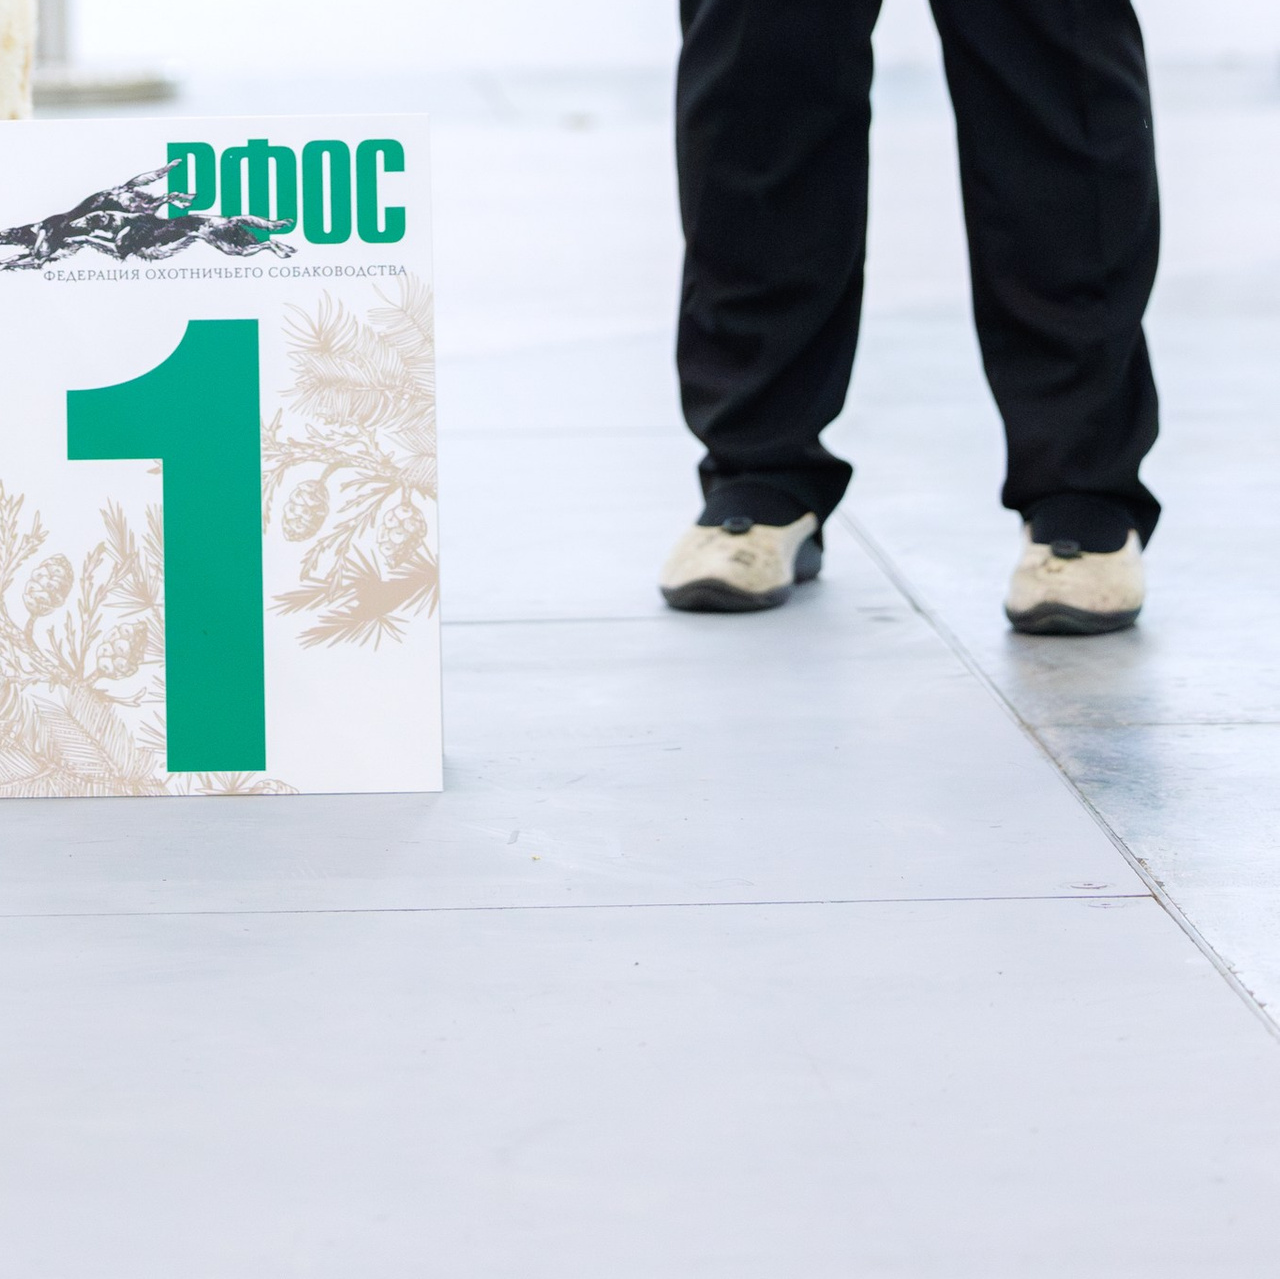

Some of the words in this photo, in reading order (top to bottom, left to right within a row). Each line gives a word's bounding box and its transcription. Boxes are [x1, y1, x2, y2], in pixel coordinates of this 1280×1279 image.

[166, 138, 406, 245] РФОС
[43, 268, 141, 283] ФЕДЕРАЦИЯ
[145, 266, 264, 281] ОХОТНИЧЬЕГО
[267, 264, 408, 279] СОБАКОВОДСТВА
[66, 318, 266, 772] 1
